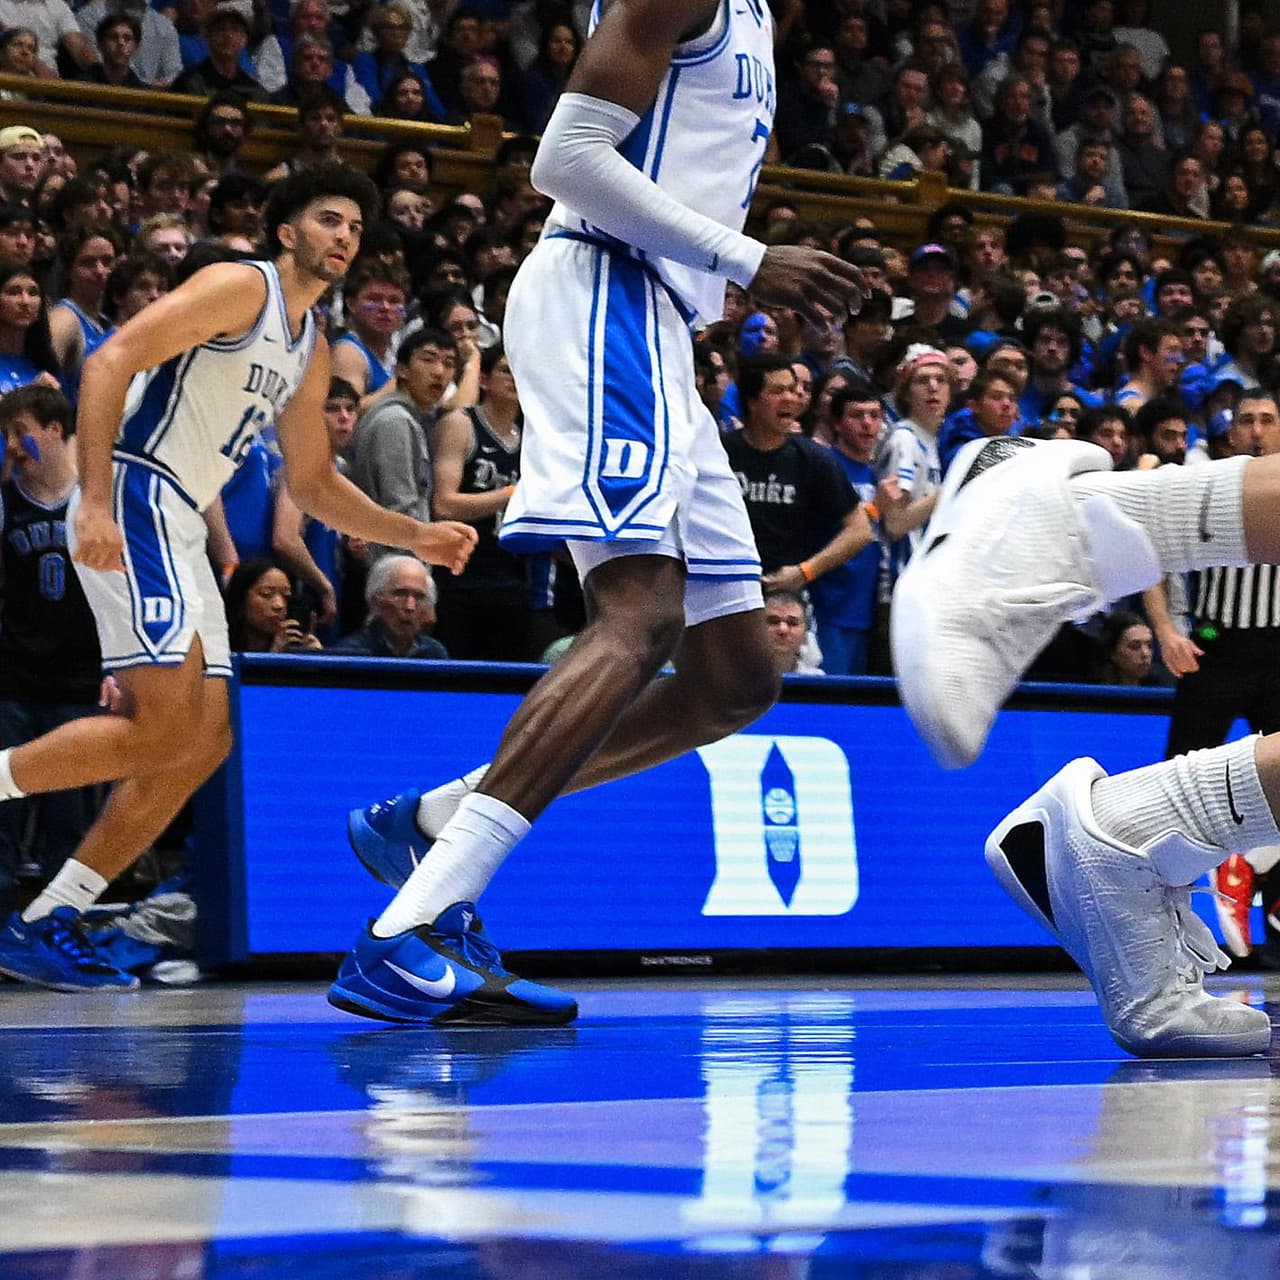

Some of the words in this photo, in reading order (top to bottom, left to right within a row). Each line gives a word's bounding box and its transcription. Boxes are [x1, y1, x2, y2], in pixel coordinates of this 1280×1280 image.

[732, 53, 777, 116] DUK
[242, 363, 289, 408] DUK
[602, 438, 649, 479] D
[8, 520, 66, 556] DUK
[143, 597, 174, 624] D
[696, 734, 860, 916] D
